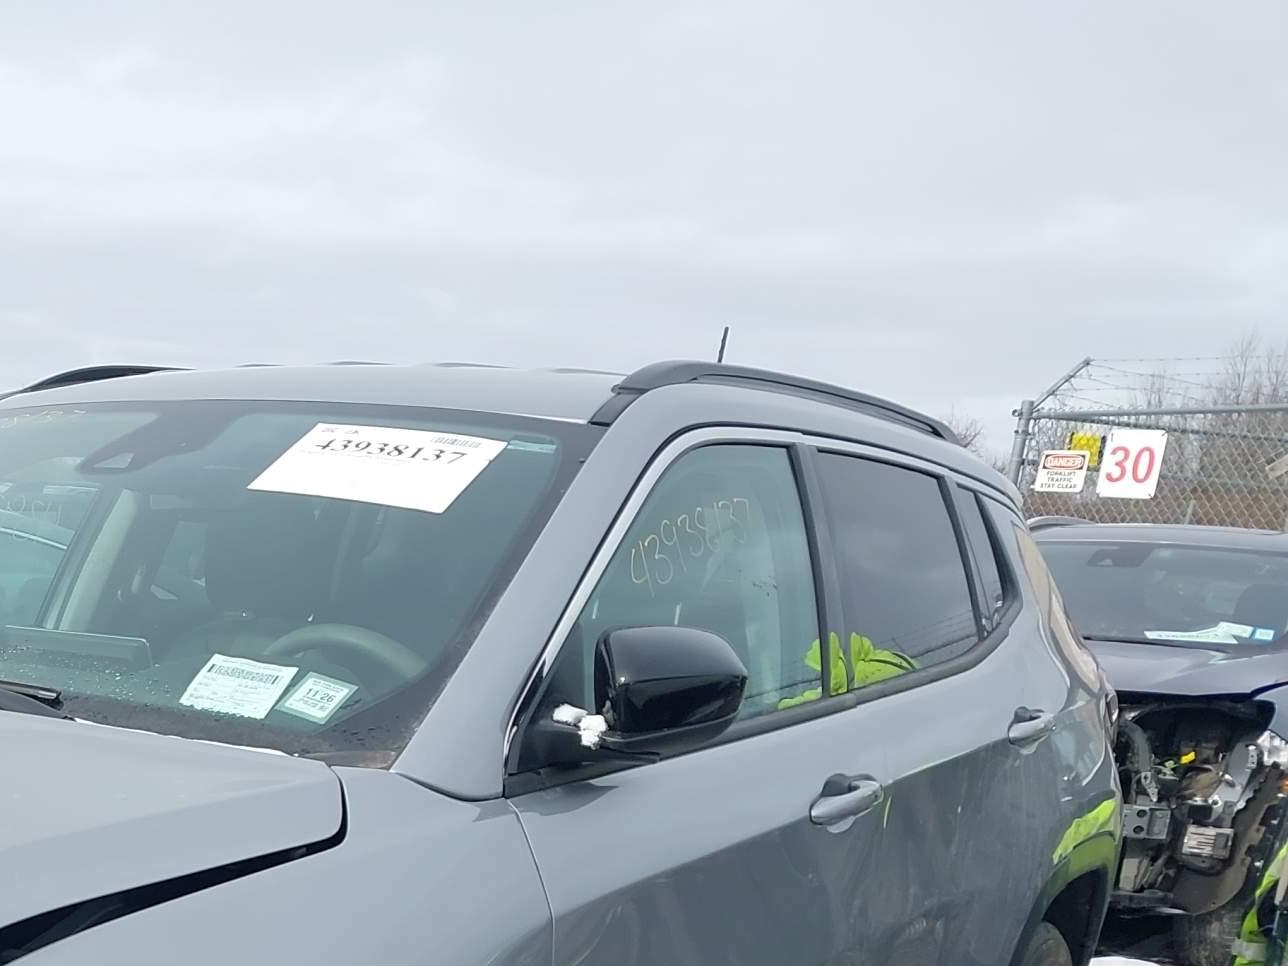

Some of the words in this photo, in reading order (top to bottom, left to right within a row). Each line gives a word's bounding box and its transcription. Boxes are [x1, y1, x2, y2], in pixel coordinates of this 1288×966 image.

[315, 437, 468, 465] 43938137
[1047, 456, 1083, 467] DANGER
[1105, 445, 1157, 484] 30
